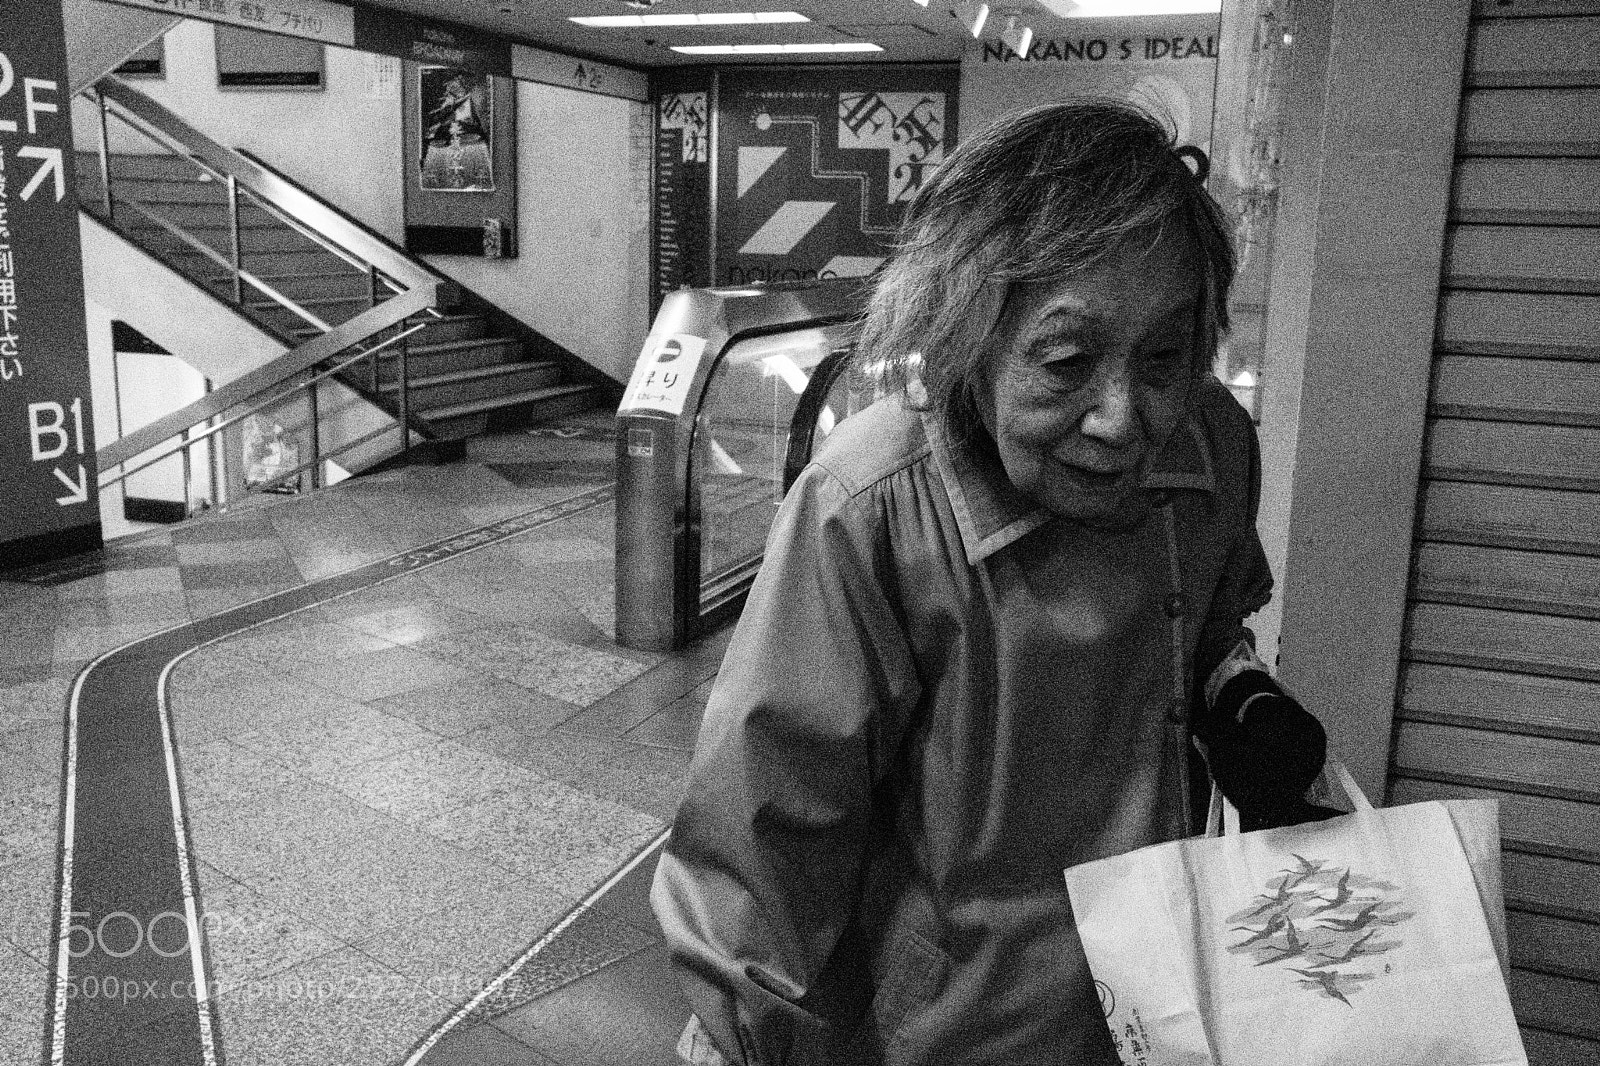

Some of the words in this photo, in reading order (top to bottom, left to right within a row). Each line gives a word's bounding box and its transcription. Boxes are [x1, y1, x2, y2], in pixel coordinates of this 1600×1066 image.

[983, 39, 1108, 62] NAKANO
[1144, 36, 1218, 60] IDEAL
[28, 397, 84, 462] B1
